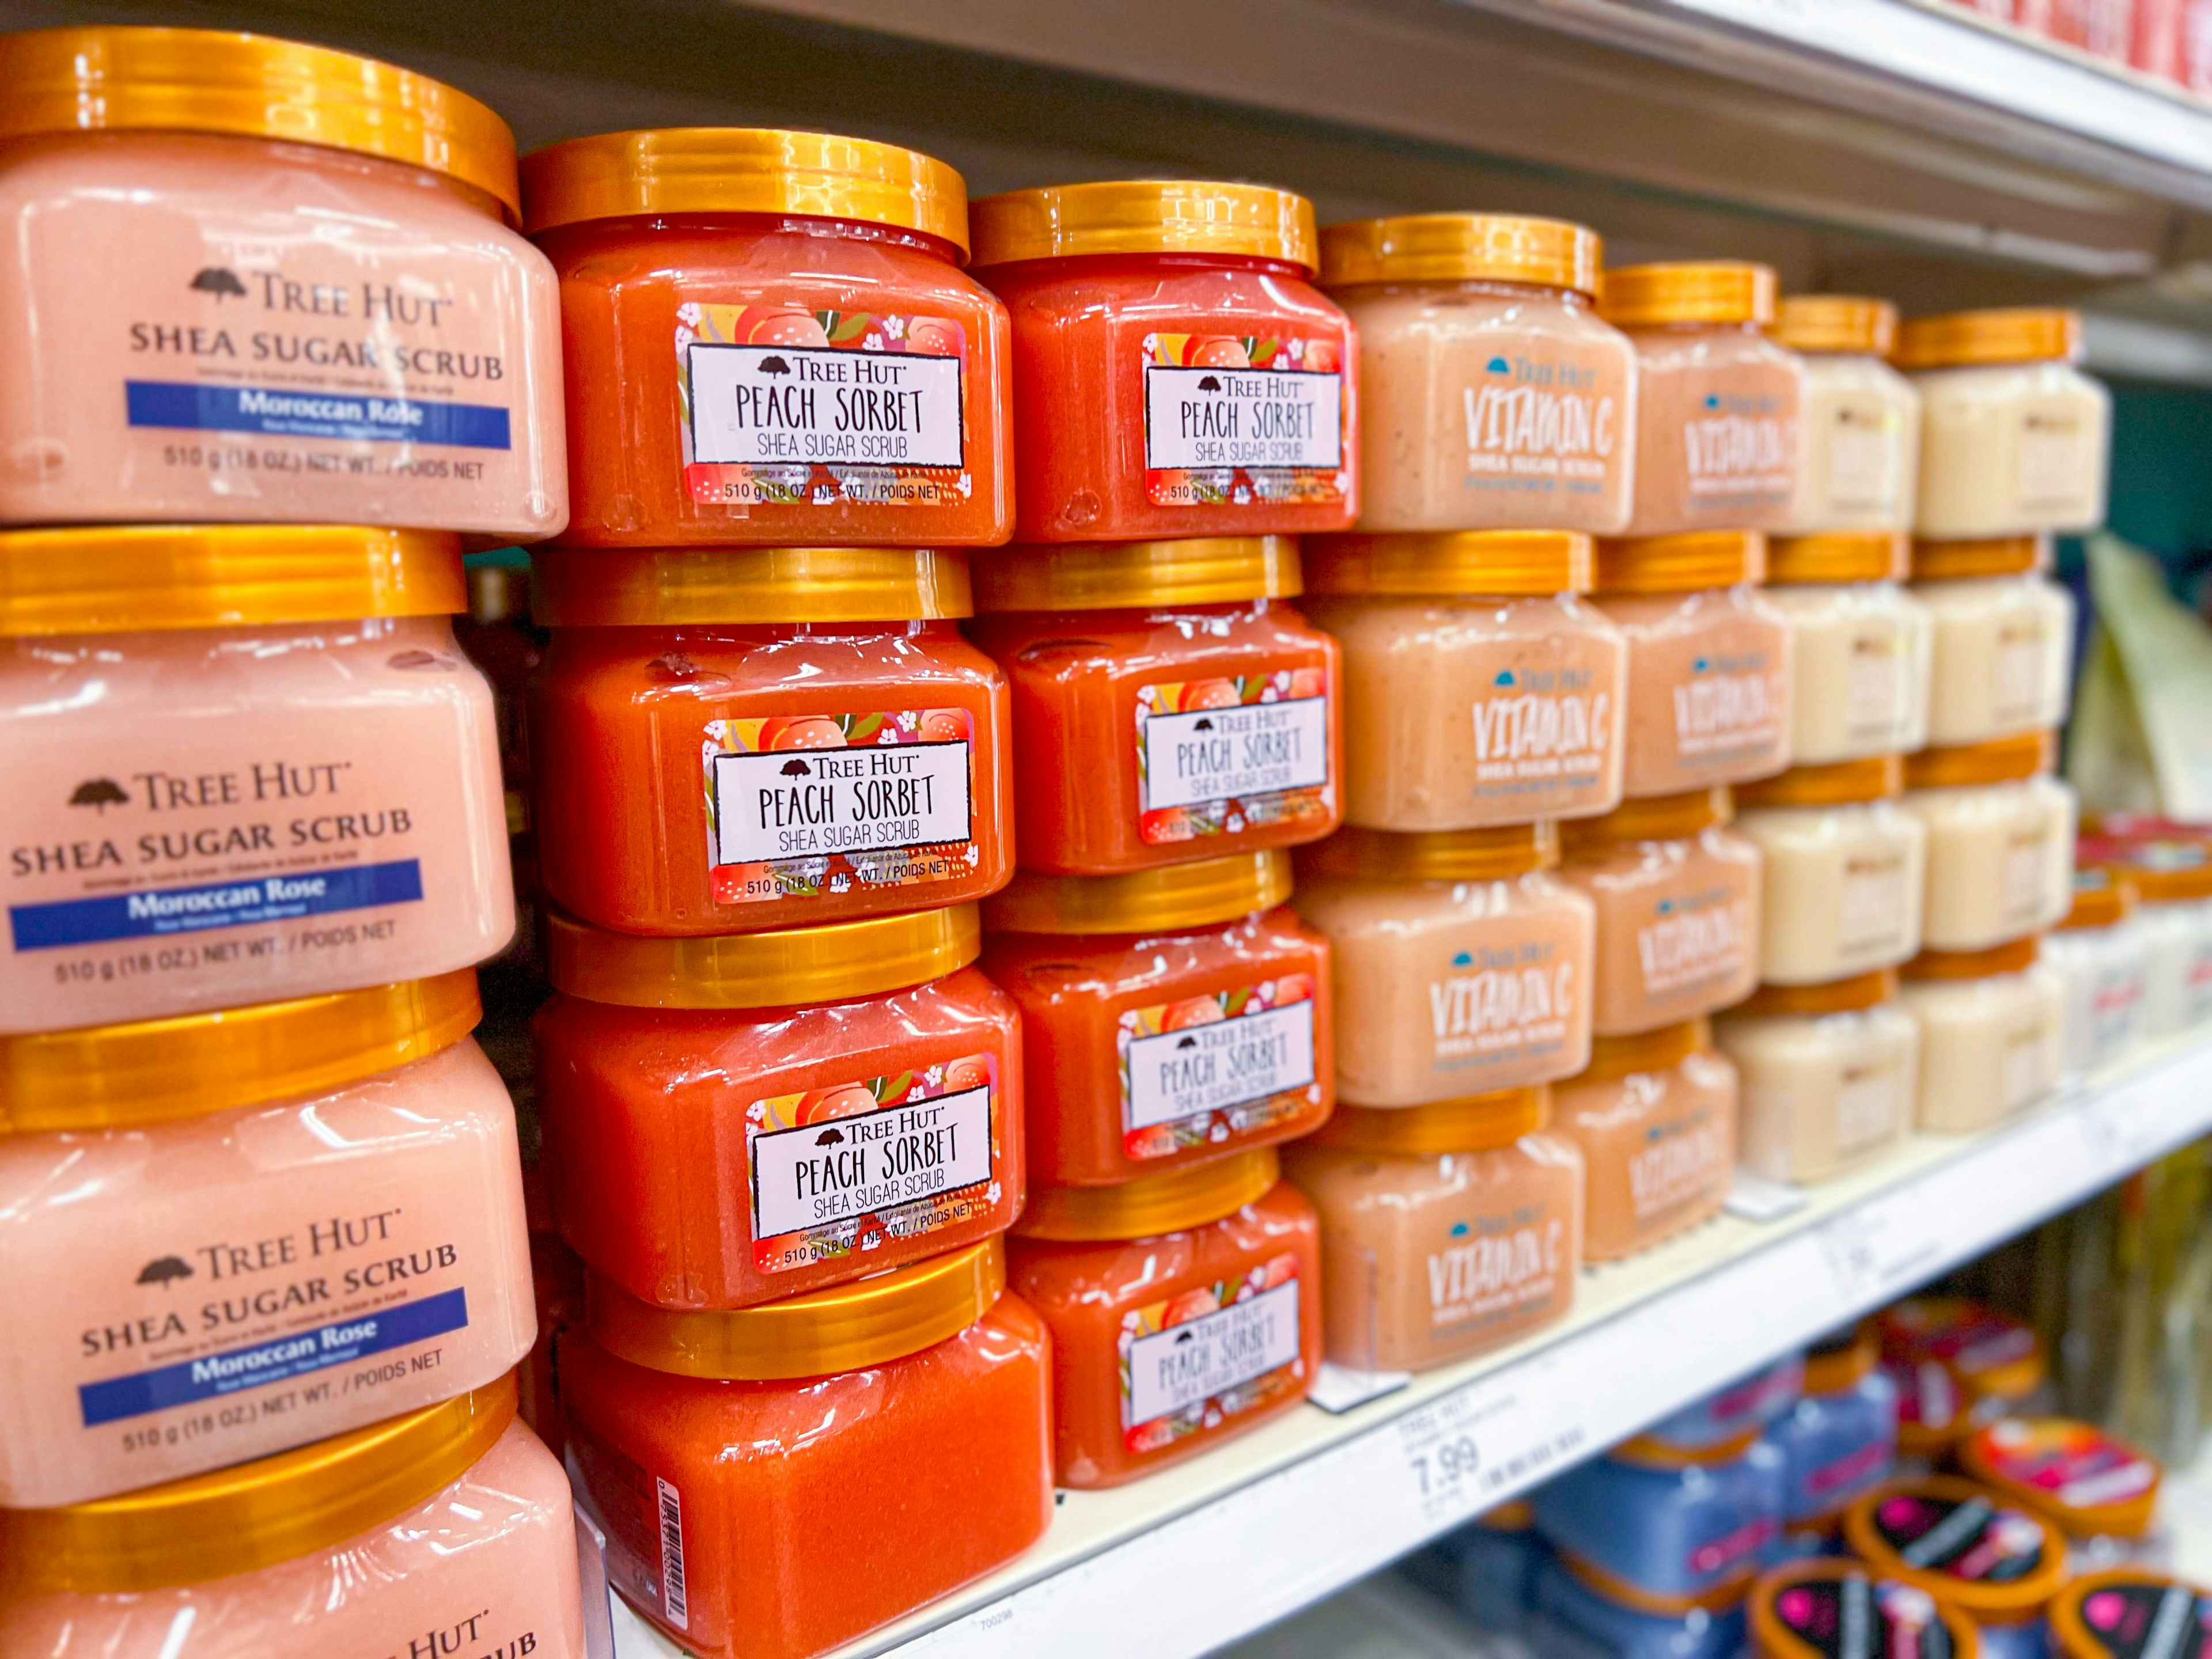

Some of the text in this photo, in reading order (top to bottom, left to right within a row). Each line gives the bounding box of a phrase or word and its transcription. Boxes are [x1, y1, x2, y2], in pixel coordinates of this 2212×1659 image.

[129, 321, 503, 380] SHEA SUGAR SCRUB
[793, 357, 903, 385] TREE HUT
[238, 389, 423, 426] Moroccan Rose
[736, 384, 924, 434] PEACH SORBET
[1222, 376, 1300, 399] TREE HUT
[1180, 400, 1314, 440] PEACH SORBET
[1463, 383, 1614, 458] VITAMIN C
[164, 444, 203, 468] 510
[454, 461, 484, 480] NET
[757, 433, 908, 459] SHEA SUGAR SCRUB
[1195, 442, 1303, 462] SHEA SUGAR SCRUB
[725, 483, 749, 498] 510
[753, 486, 762, 501] g
[766, 483, 786, 500] (18
[819, 484, 840, 499] NET
[880, 484, 915, 499] POIDS
[918, 485, 940, 499] NET
[1170, 484, 1215, 500] 510 g (18
[1217, 714, 1252, 735] TREE
[1472, 694, 1588, 761] VITAMIN
[1590, 691, 1609, 751] C
[813, 752, 914, 780] TREE HUT
[1177, 726, 1301, 779] PEACH SORBET
[131, 771, 240, 812] TREE
[759, 774, 935, 830] PEACH SORBET
[1190, 779, 1219, 797] SHEA
[10, 838, 123, 877] SHEA
[137, 824, 276, 863] SUGAR
[289, 808, 411, 847] SCRUB
[778, 819, 920, 853] SHEA SUGAR SCRUB
[127, 887, 261, 920] Moroccan
[265, 878, 326, 902] Rose
[747, 880, 771, 894] 510
[774, 881, 782, 894] g
[786, 876, 805, 892] (18
[835, 870, 856, 885] NET
[861, 868, 883, 881] WT.
[885, 866, 891, 880] /
[893, 862, 926, 880] POIDS
[929, 859, 949, 874] NET
[55, 960, 95, 984] 510
[119, 952, 152, 977] (18
[203, 941, 239, 963] NET
[301, 925, 357, 952] POIDS
[361, 919, 395, 940] NET
[1429, 969, 1551, 1038] VITAMIN
[1160, 1034, 1287, 1096] PEACH SORBET
[846, 1108, 941, 1146] TREE HUT
[796, 1123, 959, 1200] PEACH SORBET
[813, 1168, 945, 1219] SHEA SUGAR SCRUB
[912, 1205, 920, 1213] de
[784, 1247, 807, 1263] 510
[810, 1247, 817, 1259] g
[820, 1240, 839, 1257] (18
[867, 1227, 887, 1244] NET
[891, 1221, 910, 1236] WT.
[913, 1216, 917, 1231] /
[921, 1209, 950, 1229] POIDS
[953, 1202, 972, 1219] NET
[196, 1234, 297, 1280] TREE
[1427, 1228, 1542, 1308] VITAMIN
[81, 1312, 186, 1358] SHEA
[202, 1277, 331, 1330] SUGAR
[343, 1243, 457, 1296] SCRUB
[192, 1336, 317, 1384] Moroccan
[320, 1320, 378, 1351] Rose
[1158, 1347, 1210, 1391] PEACH
[122, 1427, 161, 1453] 510
[165, 1427, 178, 1446] g
[183, 1413, 214, 1439] (18
[262, 1392, 297, 1415] NET
[354, 1361, 406, 1392] POIDS
[410, 1348, 444, 1373] NET
[1409, 1435, 1479, 1497] 7.99
